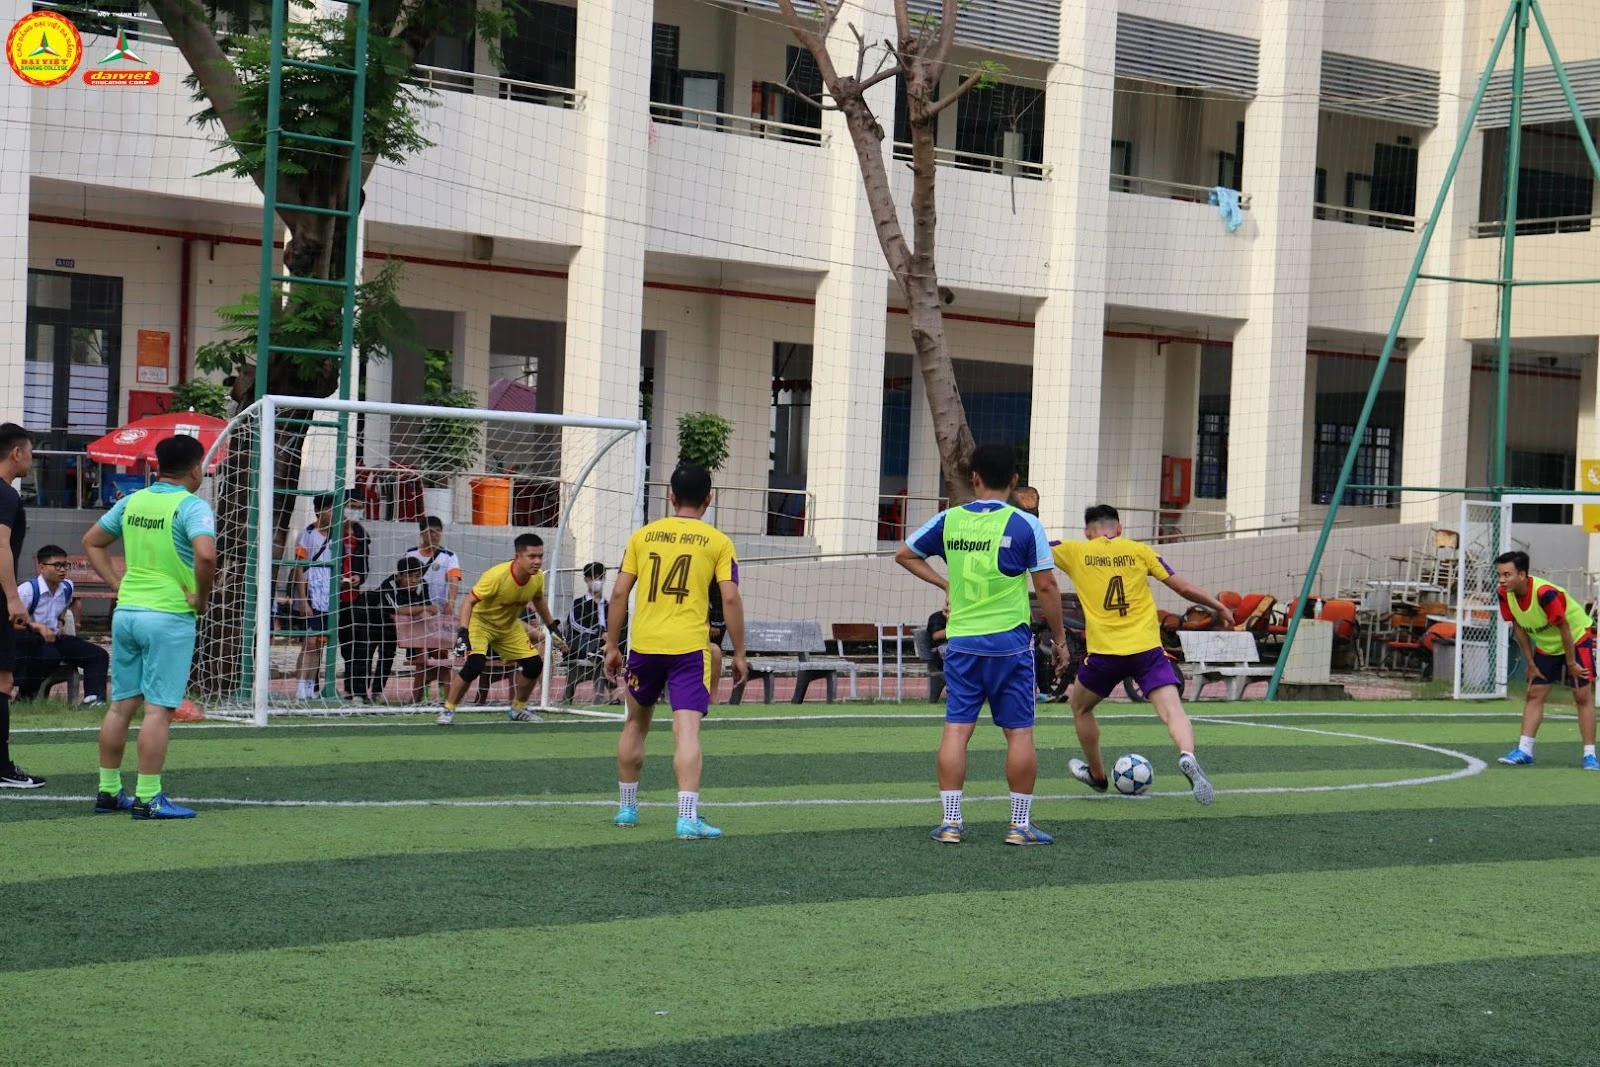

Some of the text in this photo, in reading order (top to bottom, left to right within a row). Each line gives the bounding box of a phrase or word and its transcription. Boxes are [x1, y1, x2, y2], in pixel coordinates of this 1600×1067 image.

[127, 514, 165, 530] vietsport
[644, 531, 709, 547] QUANG ARMY
[946, 537, 991, 552] vietsport
[1084, 554, 1136, 568] QUANG ARMY
[647, 552, 692, 605] 14
[1103, 575, 1130, 617] 4
